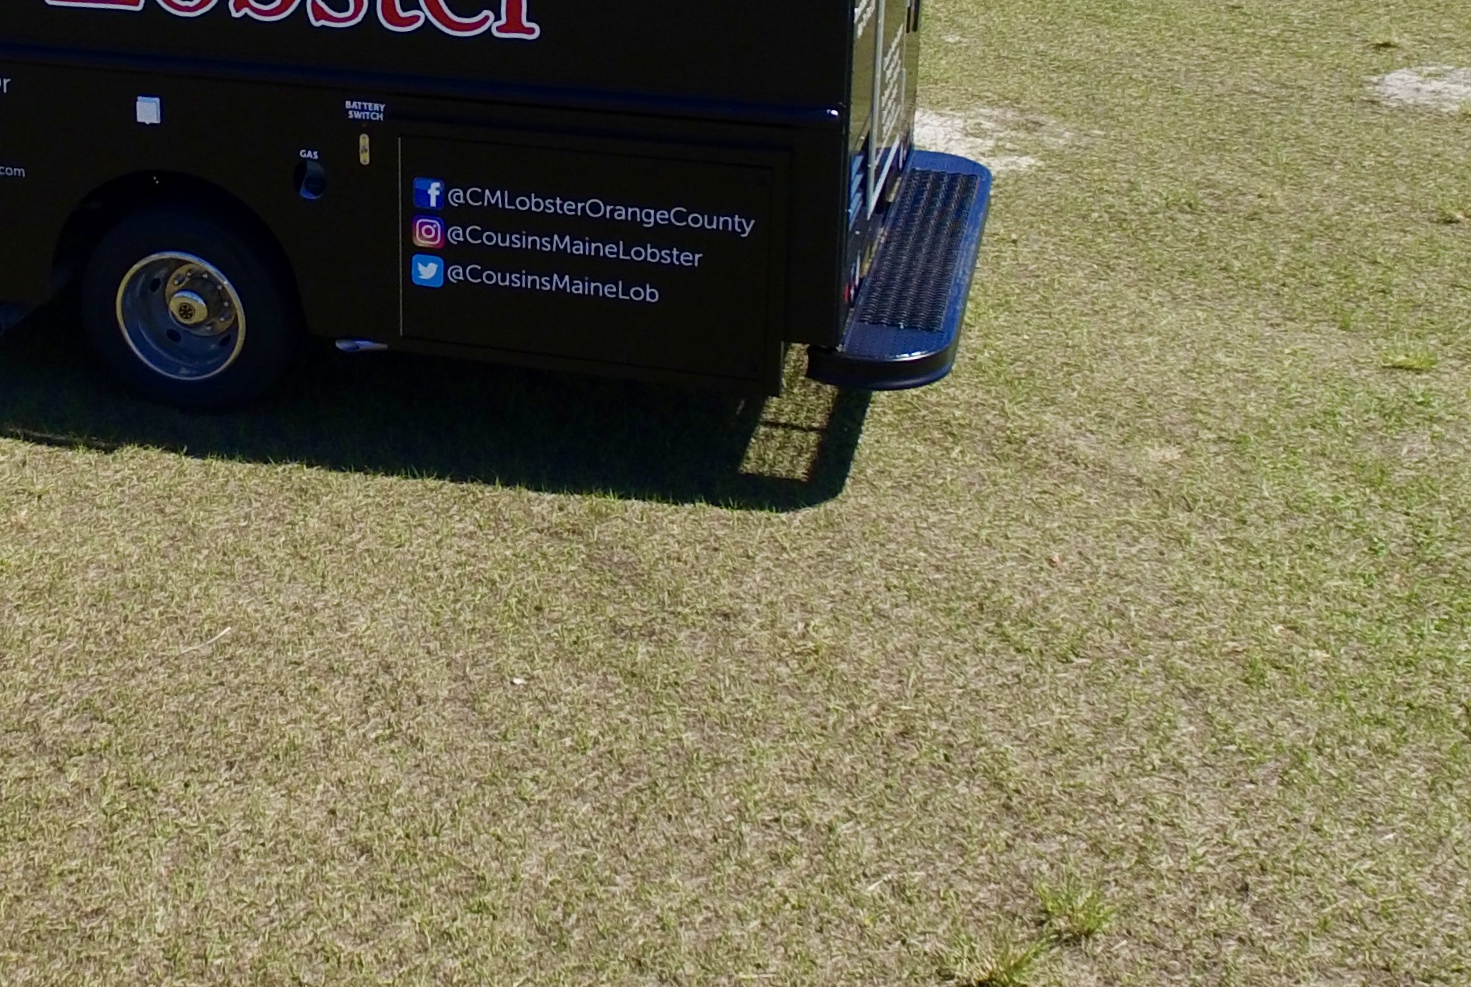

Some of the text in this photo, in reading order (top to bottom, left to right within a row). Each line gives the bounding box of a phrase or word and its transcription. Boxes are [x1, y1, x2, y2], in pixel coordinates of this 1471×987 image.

[345, 100, 386, 112] BATTERY
[348, 110, 384, 121] SWITCH
[299, 149, 319, 160] GAS
[447, 187, 755, 238] @CMLobsterOrangeCounty
[447, 225, 703, 267] @CousinsMaineLobster
[447, 264, 659, 303] @CousinsMaineLob
